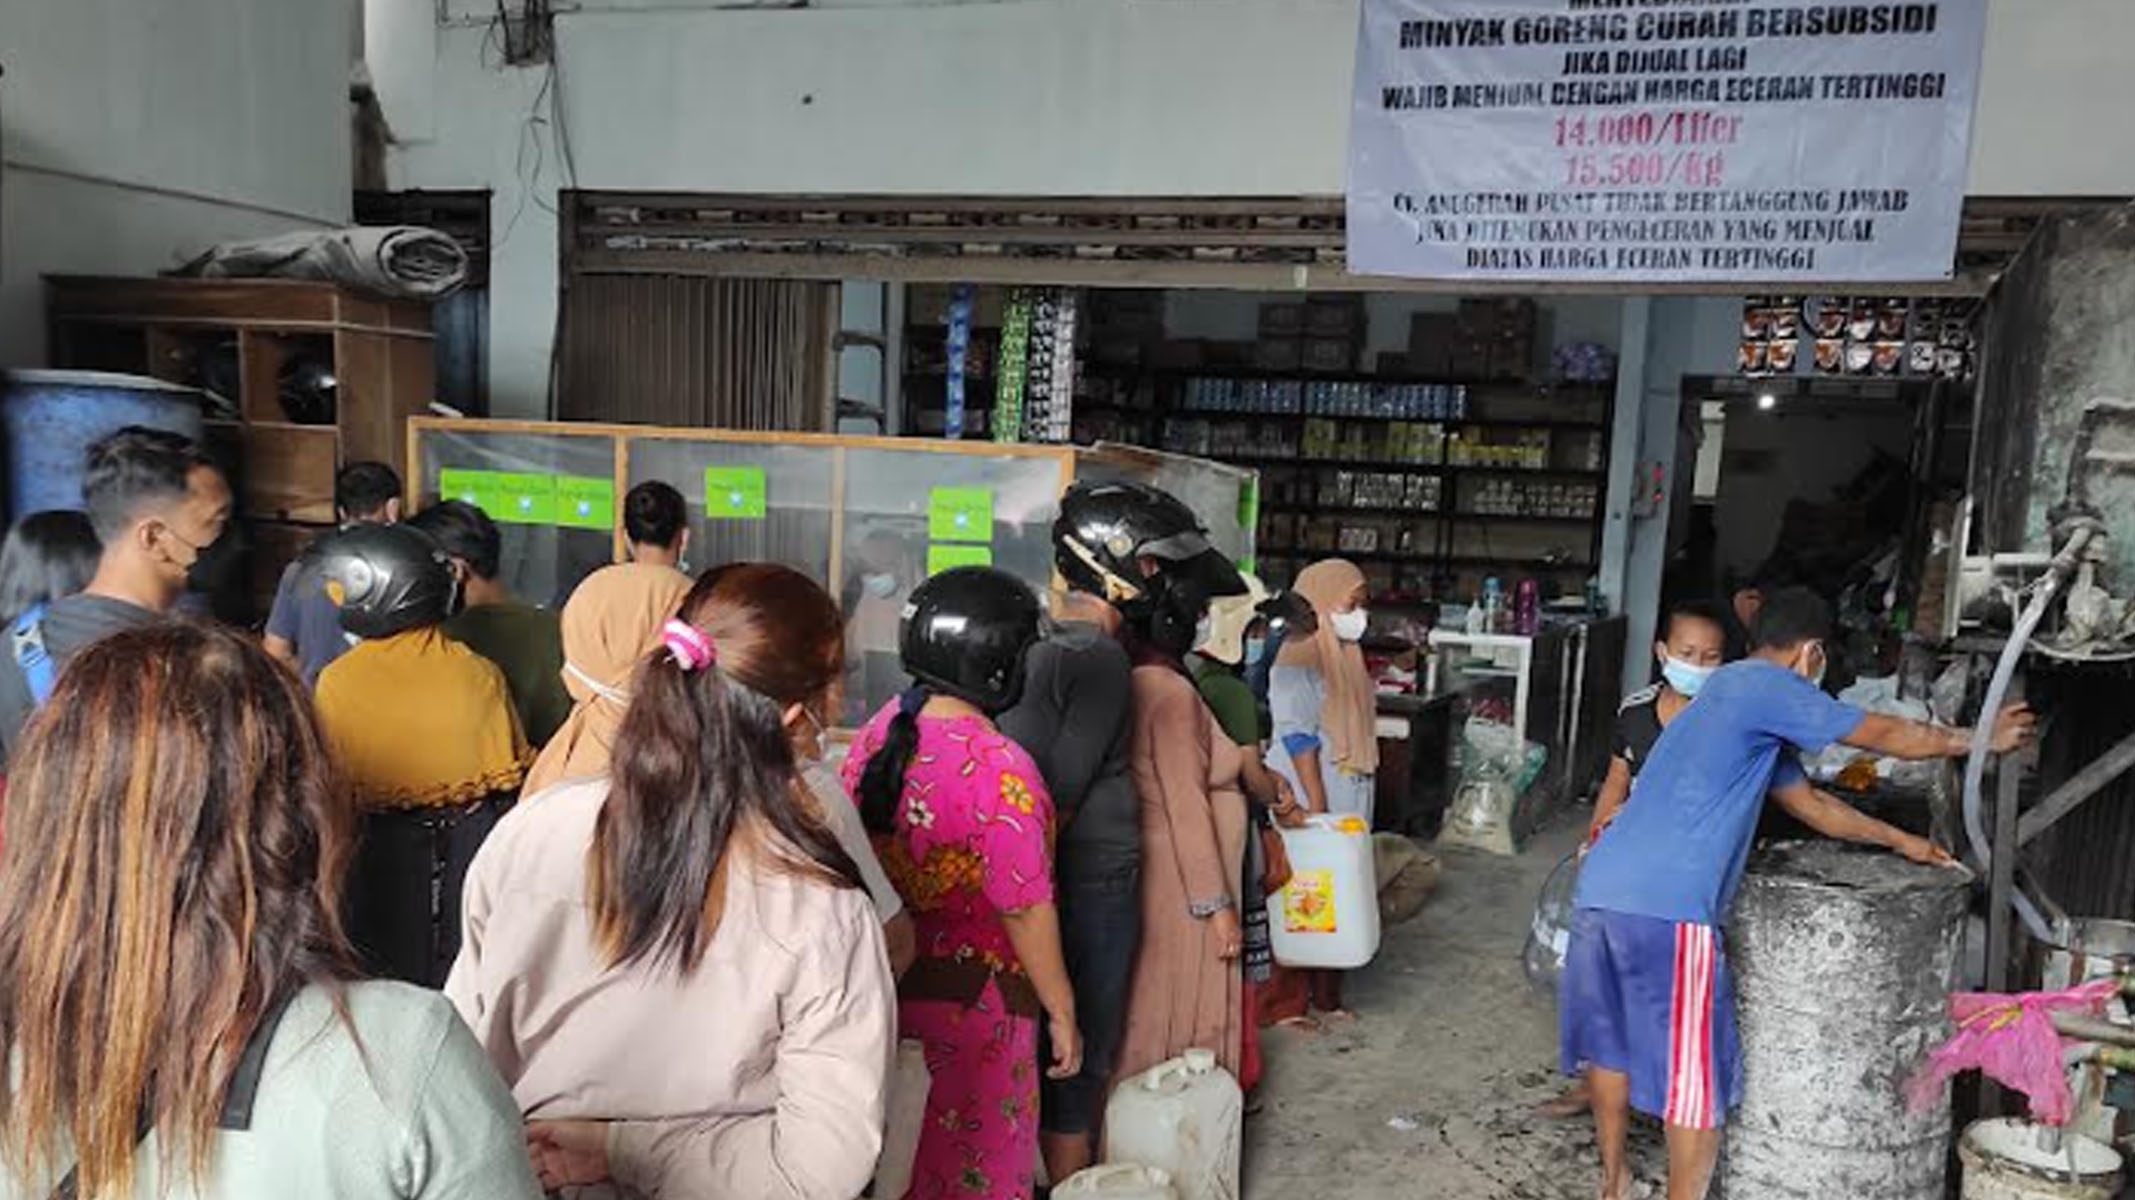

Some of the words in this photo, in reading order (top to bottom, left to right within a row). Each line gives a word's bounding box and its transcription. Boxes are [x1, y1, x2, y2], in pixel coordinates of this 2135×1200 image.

[1400, 18, 1505, 50] MINYAK
[1512, 13, 1628, 45] GORENG
[1635, 10, 1738, 41] CURAH
[1746, 3, 1937, 38] BERSUBSIDI
[1562, 51, 1610, 75] JIKA
[1615, 47, 1689, 74] DIJUAL
[1695, 46, 1747, 72] LAGI
[1382, 85, 1448, 110] WAJIB
[1452, 82, 1546, 109] MENJUAL
[1551, 79, 1638, 106] DENGAN
[1643, 78, 1720, 102] HARGA
[1724, 75, 1814, 101] ECERAN
[1820, 72, 1946, 99] TERTINGGI
[1674, 190, 1830, 213] BERTANGGUNG
[1836, 189, 1909, 214] JAWAB
[1722, 219, 1777, 241] YANG
[1784, 218, 1874, 243] MENJUAL
[1467, 247, 1533, 269] DIATAS
[1540, 246, 1608, 269] HARGA
[1616, 246, 1692, 269] ECERAN
[1700, 246, 1815, 270] TERTINGGI
